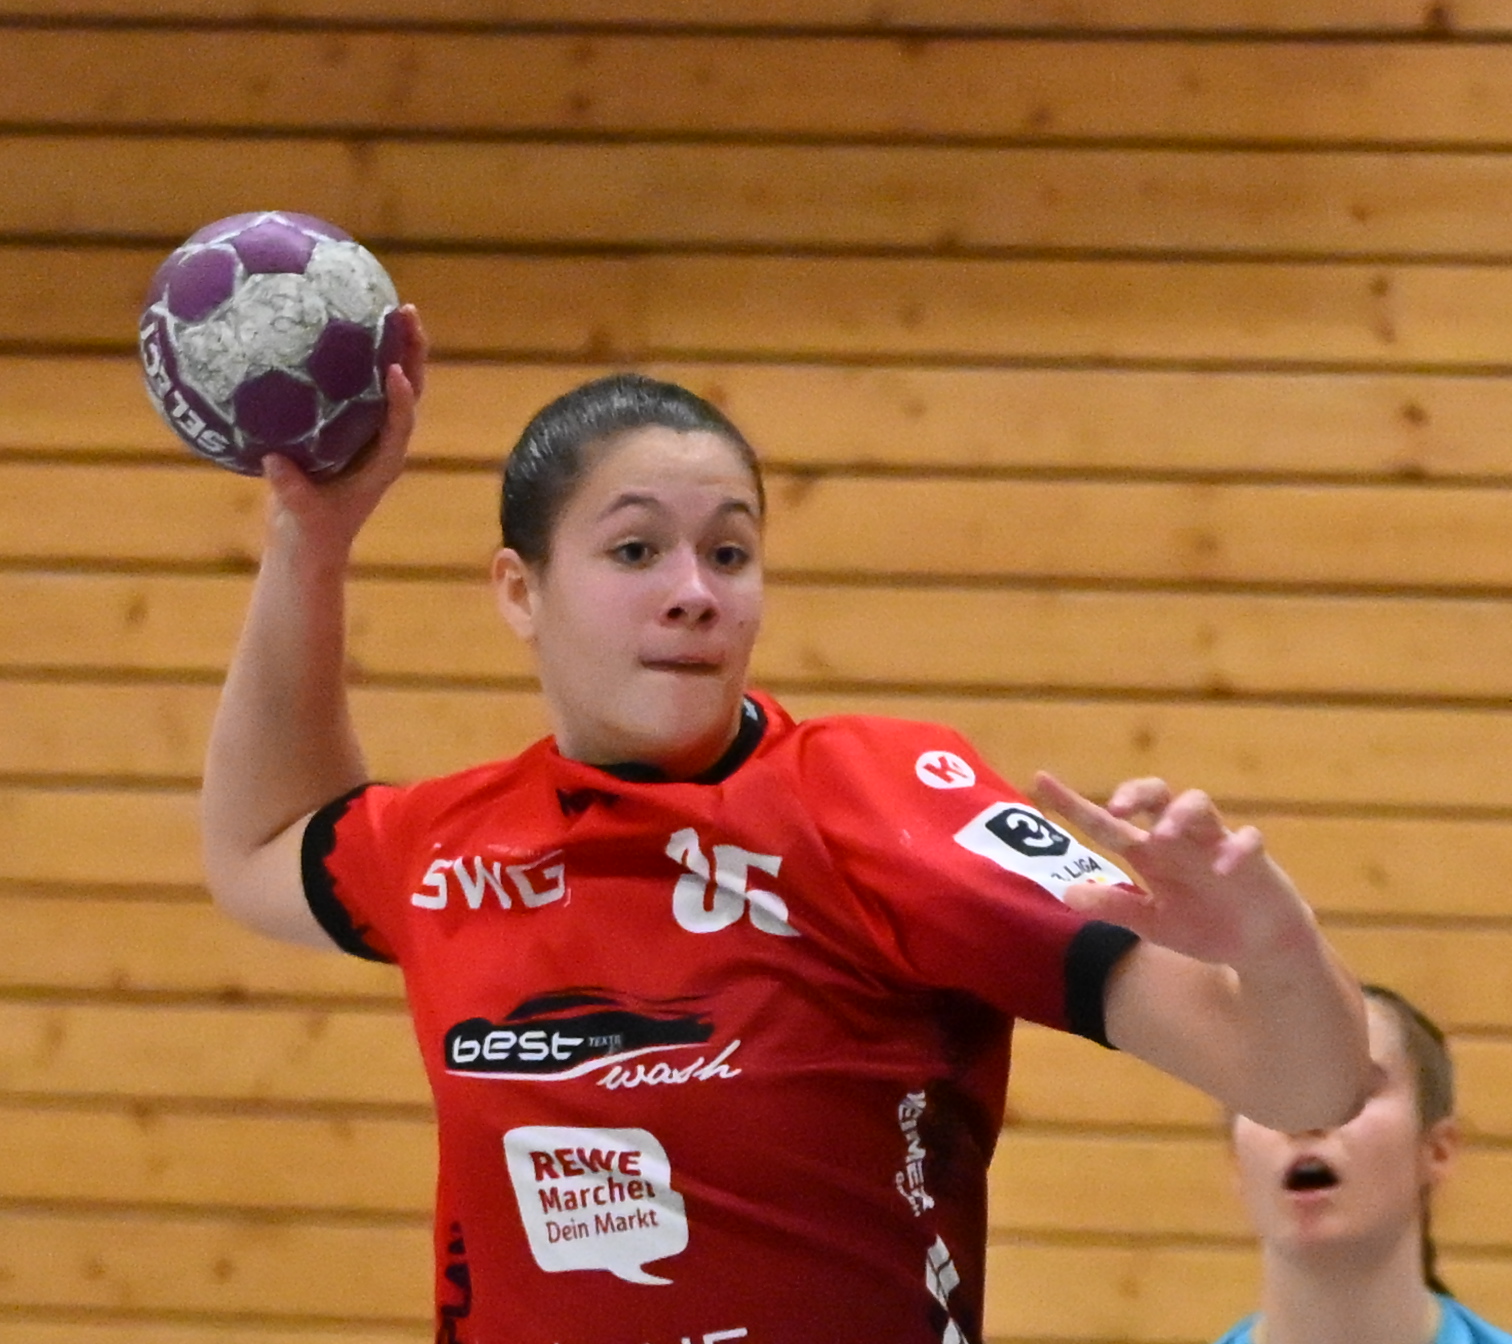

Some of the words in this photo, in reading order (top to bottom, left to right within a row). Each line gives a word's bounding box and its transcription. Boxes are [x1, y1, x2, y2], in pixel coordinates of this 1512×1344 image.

[411, 847, 566, 911] SWG
[452, 1029, 584, 1064] best
[596, 1039, 742, 1090] wash
[528, 1147, 642, 1182] REWE
[546, 1218, 590, 1244] Dein
[593, 1207, 660, 1236] Markt
